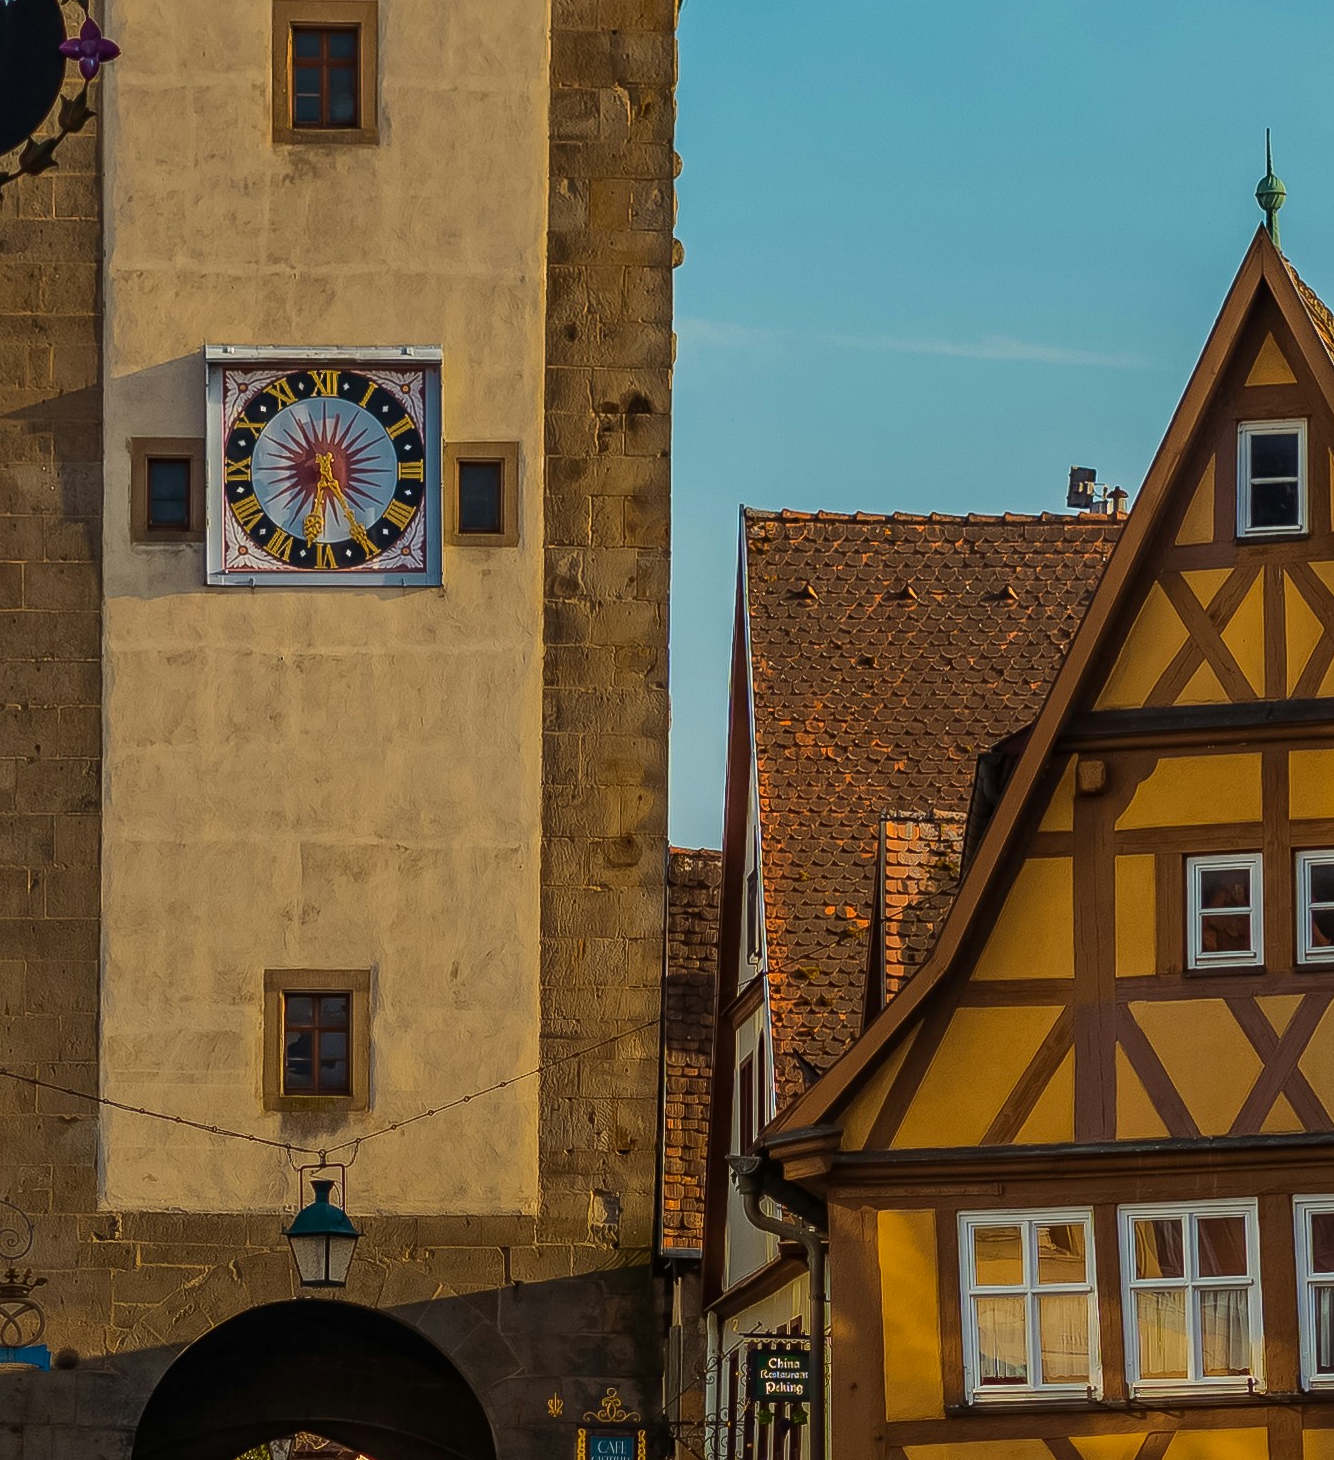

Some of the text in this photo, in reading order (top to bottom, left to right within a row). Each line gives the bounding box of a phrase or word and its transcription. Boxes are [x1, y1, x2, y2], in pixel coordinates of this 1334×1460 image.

[263, 377, 298, 412] XI
[307, 370, 341, 397] XII
[234, 413, 267, 439] X
[386, 414, 416, 440] II
[225, 456, 252, 484] IX
[398, 459, 424, 483] III
[768, 1357, 801, 1369] China
[765, 1381, 803, 1395] Peking
